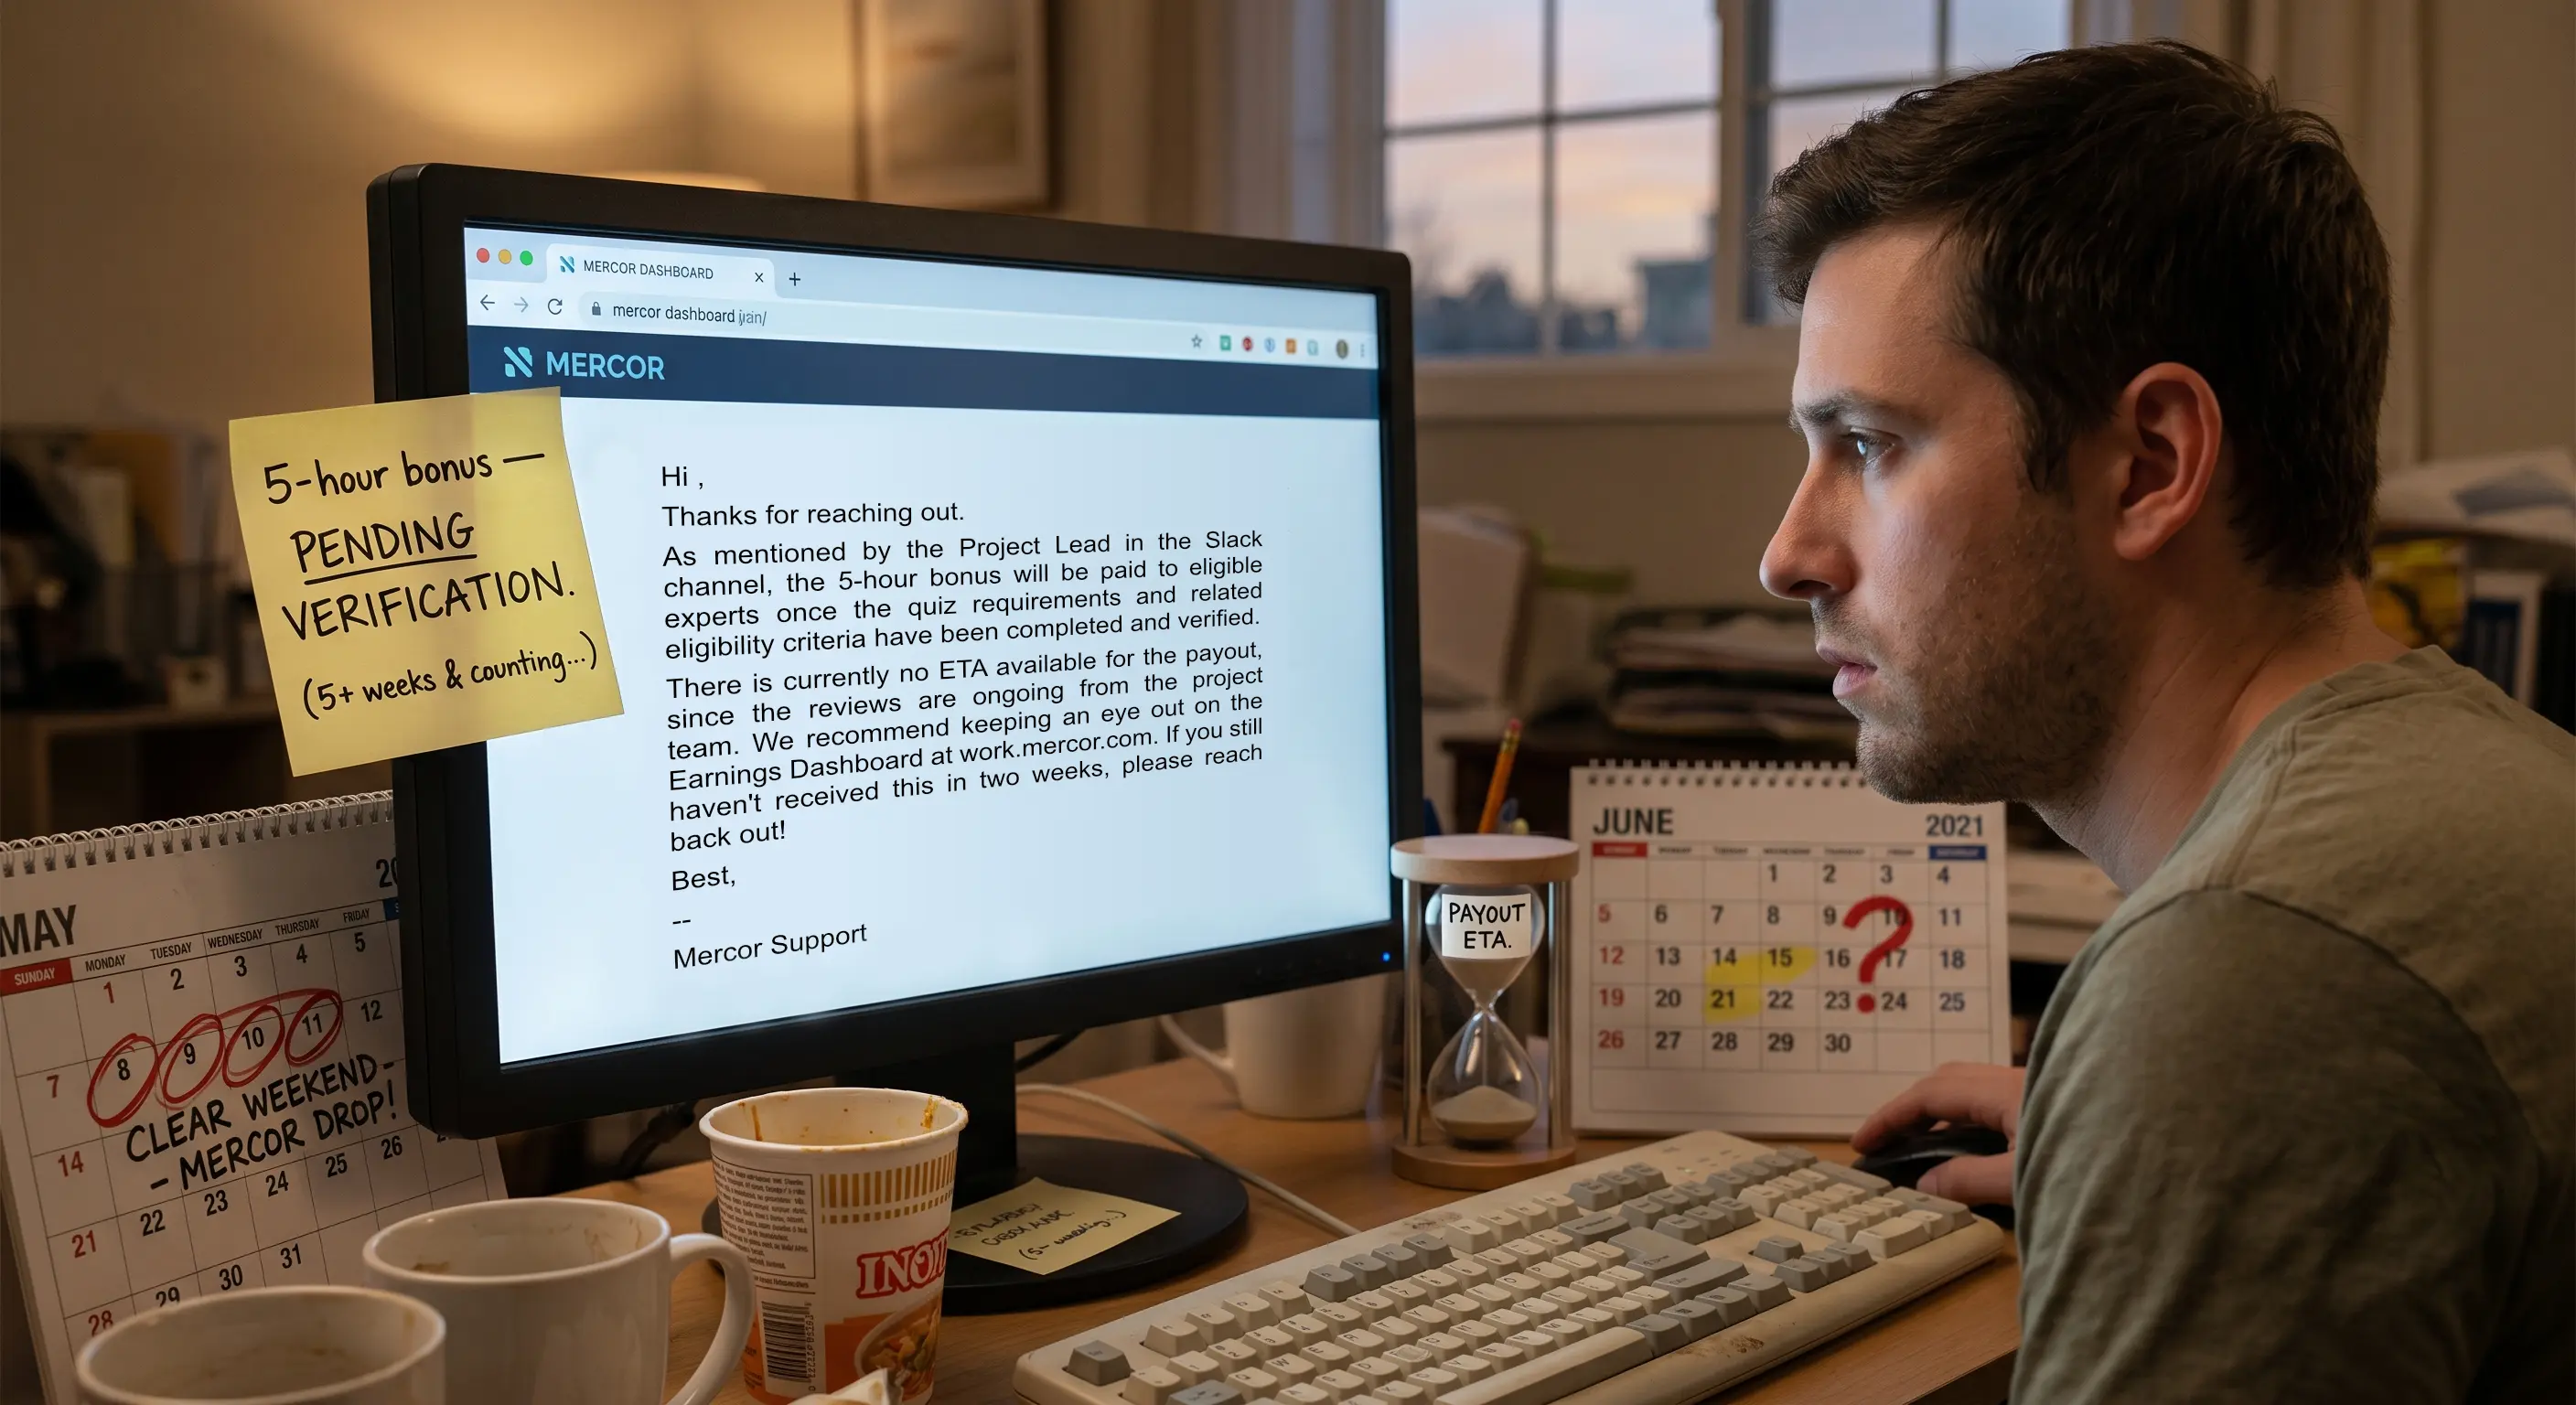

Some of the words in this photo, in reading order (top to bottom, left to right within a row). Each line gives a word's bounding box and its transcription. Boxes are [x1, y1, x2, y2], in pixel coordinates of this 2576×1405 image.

[583, 258, 638, 276] MERCOR
[639, 262, 714, 281] DASHBOARD
[612, 304, 661, 319] mercor
[664, 305, 735, 324] dashboard
[546, 350, 666, 381] MERCOR
[263, 458, 390, 505] 5-hour
[401, 450, 493, 487] bonus
[662, 467, 687, 487] Hi
[661, 506, 757, 526] Thanks
[766, 505, 799, 524] for
[809, 503, 911, 526] reaching
[921, 503, 963, 520] out.
[289, 510, 475, 574] PENDING
[662, 546, 696, 566] As
[715, 542, 845, 564] mentioned
[864, 542, 891, 564] by
[907, 540, 943, 558] the
[961, 537, 1040, 561] Project
[1057, 534, 1110, 553] Lead
[1126, 534, 1143, 551] in
[1158, 532, 1191, 550] the
[1207, 531, 1262, 548] Slack
[664, 574, 771, 597] channel,
[787, 573, 824, 592] the
[840, 571, 918, 590] 5-hour
[931, 568, 1001, 586] bonus
[1014, 563, 1047, 583] will
[1062, 563, 1088, 581] be
[1101, 560, 1145, 584] paid
[1158, 561, 1177, 576] to
[1190, 556, 1261, 579] eligible
[281, 560, 575, 641] VERIFICATION.
[665, 606, 758, 632] experts
[778, 606, 836, 622] once
[853, 600, 891, 618] the
[908, 596, 957, 620] quiz
[973, 590, 1121, 616] requirements
[1137, 585, 1175, 605] and
[1192, 582, 1261, 602] related
[666, 635, 774, 662] eligibility
[784, 629, 865, 652] criteria
[875, 628, 932, 647] have
[941, 625, 997, 643] been
[1007, 615, 1122, 640] completed
[1131, 613, 1169, 631] and
[1178, 608, 1259, 628] verified.
[303, 677, 355, 721] (5+
[361, 669, 437, 703] weeks
[444, 658, 464, 690] &
[470, 629, 598, 683] counting...)
[666, 678, 741, 698] There
[754, 673, 772, 692] is
[784, 666, 889, 690] currently
[901, 668, 928, 682] no
[940, 659, 988, 680] ETA
[997, 652, 1096, 675] available
[1106, 650, 1134, 668] for
[1143, 648, 1176, 665] the
[1186, 642, 1261, 667] payout,
[668, 709, 734, 729] since
[752, 702, 790, 723] the
[810, 696, 901, 718] reviews
[919, 693, 956, 709] are
[973, 683, 1063, 707] ongoing
[1079, 679, 1128, 697] from
[1144, 674, 1177, 692] the
[1194, 667, 1262, 692] project
[668, 741, 738, 760] team.
[752, 732, 793, 752] We
[808, 717, 949, 747] recommend
[962, 712, 1050, 735] keeping
[1063, 711, 1089, 725] an
[1101, 707, 1140, 725] eye
[1152, 699, 1185, 717] out
[1195, 700, 1219, 713] on
[1230, 693, 1262, 711] the
[671, 766, 781, 790] Earnings
[791, 748, 922, 778] Dashboard
[931, 746, 953, 765] at
[960, 732, 1157, 762] work.mercor.com.
[1167, 724, 1180, 743] If
[1186, 725, 1222, 745] you
[1230, 717, 1261, 736] still
[671, 794, 761, 821] haven't
[777, 781, 878, 810] received
[893, 777, 933, 798] this
[948, 774, 966, 792] in
[980, 771, 1019, 788] two
[1032, 761, 1109, 783] weeks,
[1123, 755, 1192, 778] please
[1206, 744, 1261, 765] reach
[671, 827, 731, 852] back
[740, 820, 784, 843] out!
[1593, 807, 1674, 836] JUNE
[1925, 814, 1984, 838] 2021
[672, 866, 735, 891] Best,
[1768, 864, 1778, 883] 1
[1822, 864, 1836, 884] 2
[1880, 864, 1894, 884] 3
[0, 905, 79, 958] MAY
[1448, 901, 1526, 926] PAYOUT
[1655, 906, 1668, 924] 6
[1711, 906, 1724, 924] 7
[1766, 906, 1780, 925] 8
[14, 967, 56, 986] SUNDAY
[84, 953, 126, 973] MONDAY
[149, 941, 193, 960] TUESDAY
[207, 927, 264, 949] WEDNESDAY
[274, 917, 321, 938] THURSDAY
[342, 907, 371, 924] FRIDAY
[675, 943, 763, 969] Mercor
[771, 924, 867, 955] Support
[1463, 929, 1512, 949] ETA.
[1655, 947, 1681, 966] 13
[1712, 947, 1737, 967] 14
[1767, 948, 1793, 967] 15
[102, 981, 116, 1004] 1
[170, 967, 185, 991] 2
[233, 955, 249, 978] 3
[295, 943, 308, 965] 4
[353, 931, 367, 953] 5
[1654, 989, 1681, 1008] 20
[1711, 990, 1735, 1009] 21
[1766, 990, 1794, 1010] 22
[1823, 991, 1851, 1011] 23
[46, 1074, 61, 1098] 7
[116, 1057, 132, 1081] 8
[182, 1042, 197, 1066] 9
[241, 1025, 265, 1051] 10
[301, 1012, 324, 1036] 11
[360, 999, 383, 1023] 12
[1655, 1032, 1682, 1050] 27
[1711, 1032, 1738, 1051] 28
[1766, 1033, 1794, 1052] 29
[1823, 1034, 1852, 1053] 30
[124, 1099, 232, 1163] CLEAR
[178, 1118, 306, 1192] MERCOR
[314, 1078, 398, 1142] DROP!
[57, 1151, 85, 1178] 14
[70, 1229, 98, 1260] 21
[139, 1208, 166, 1237] 22
[203, 1189, 230, 1217] 23
[264, 1170, 290, 1197] 24
[325, 1152, 349, 1179] 25
[380, 1134, 403, 1161] 26
[218, 1265, 244, 1292] 30
[279, 1242, 302, 1270] 31
